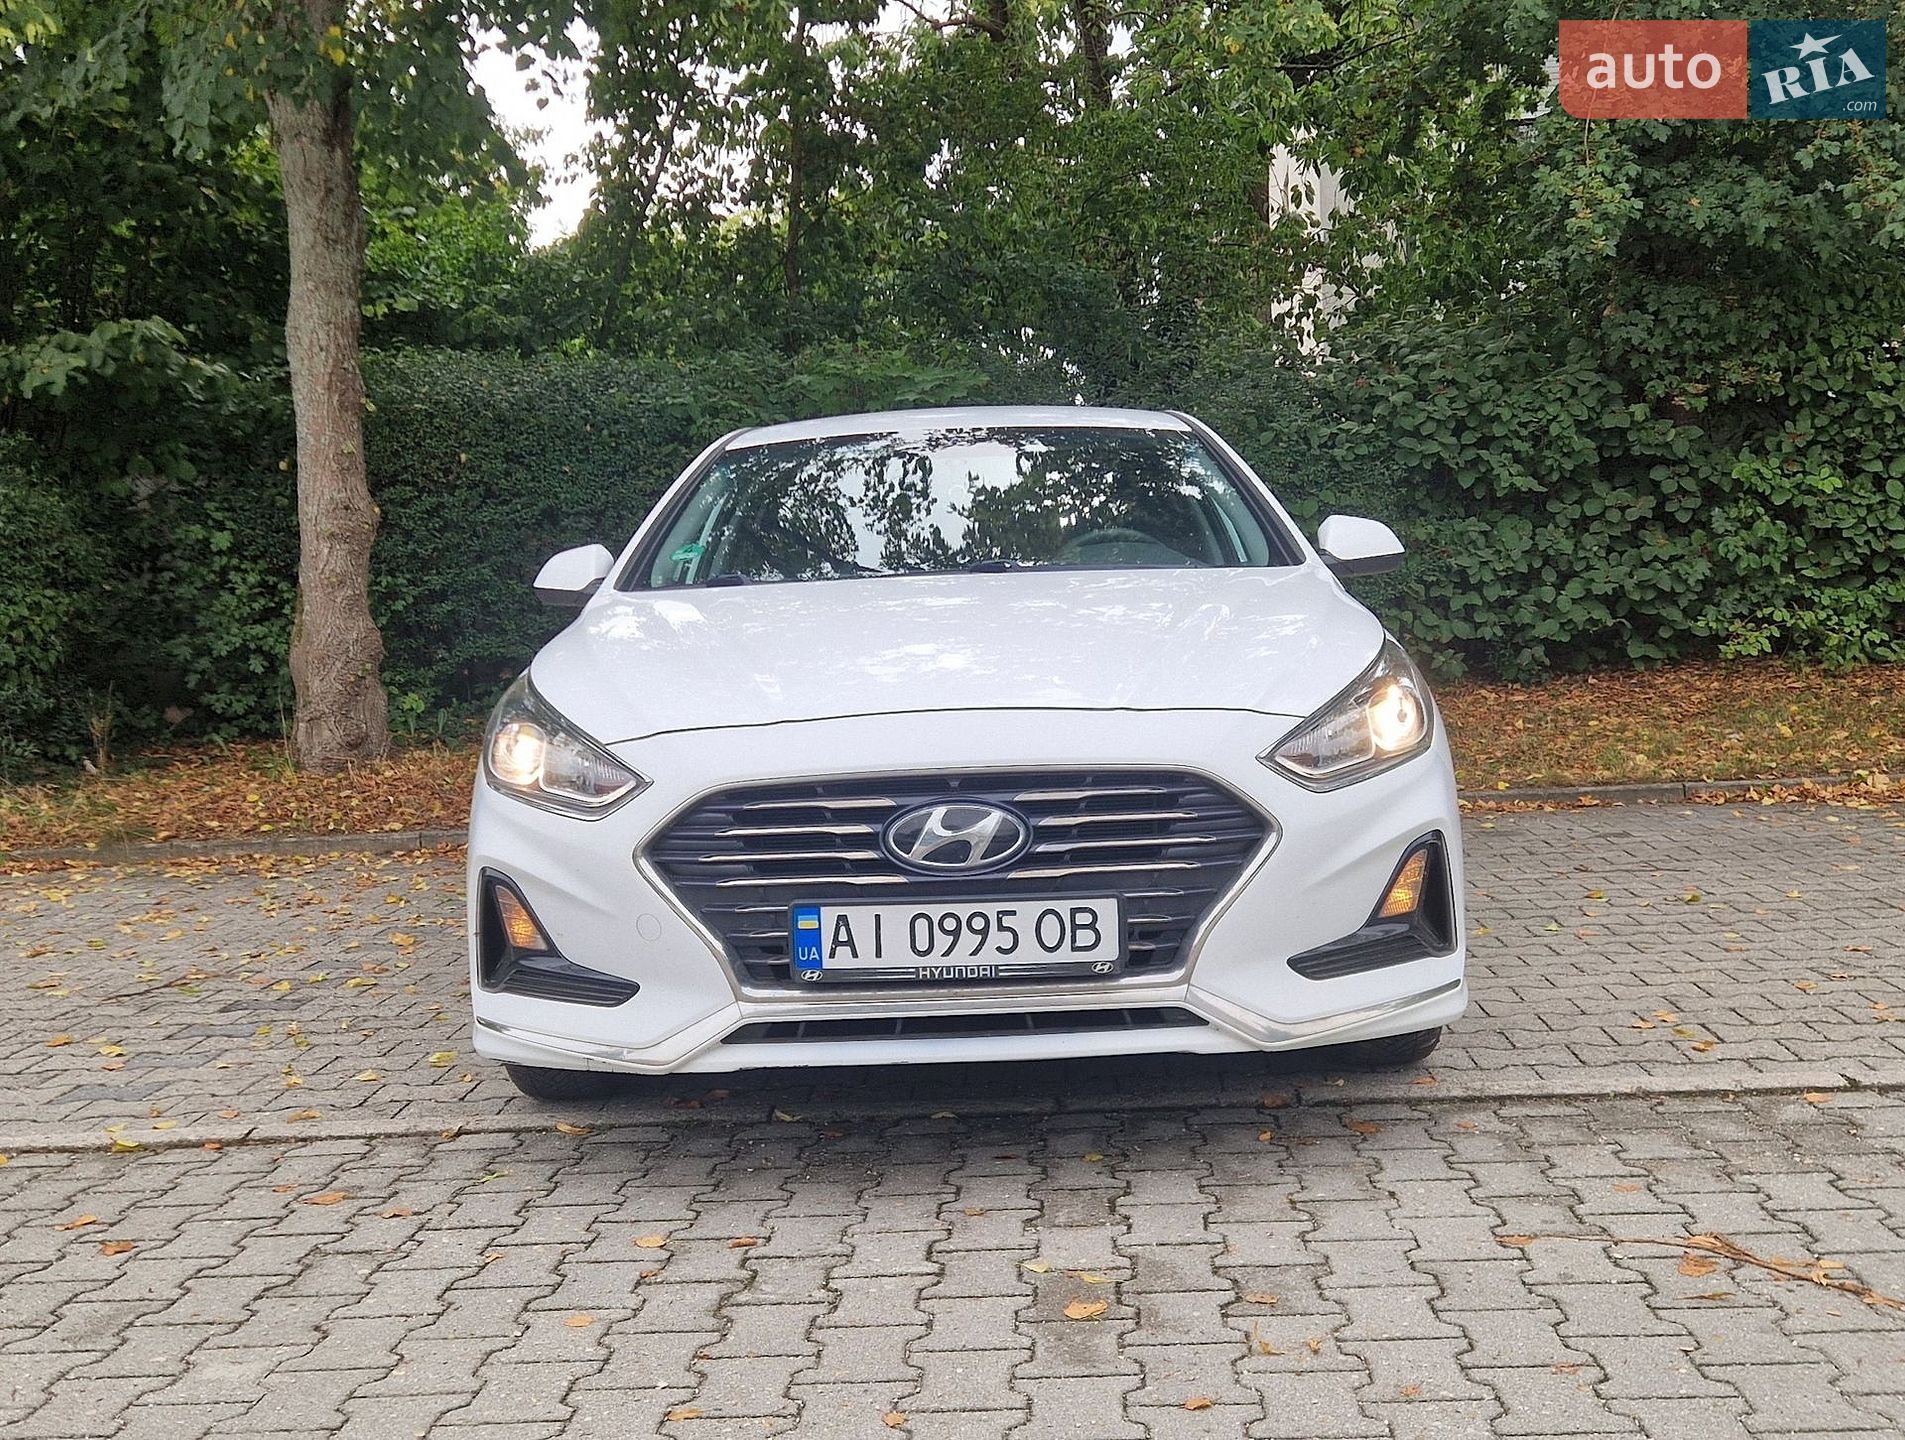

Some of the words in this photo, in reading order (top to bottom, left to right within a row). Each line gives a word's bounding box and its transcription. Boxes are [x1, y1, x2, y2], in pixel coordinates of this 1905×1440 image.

[828, 914, 883, 959] AI
[909, 910, 1019, 957] 0995
[1035, 907, 1101, 953] OB
[798, 947, 820, 961] UA
[919, 966, 995, 979] HYUNDAI
